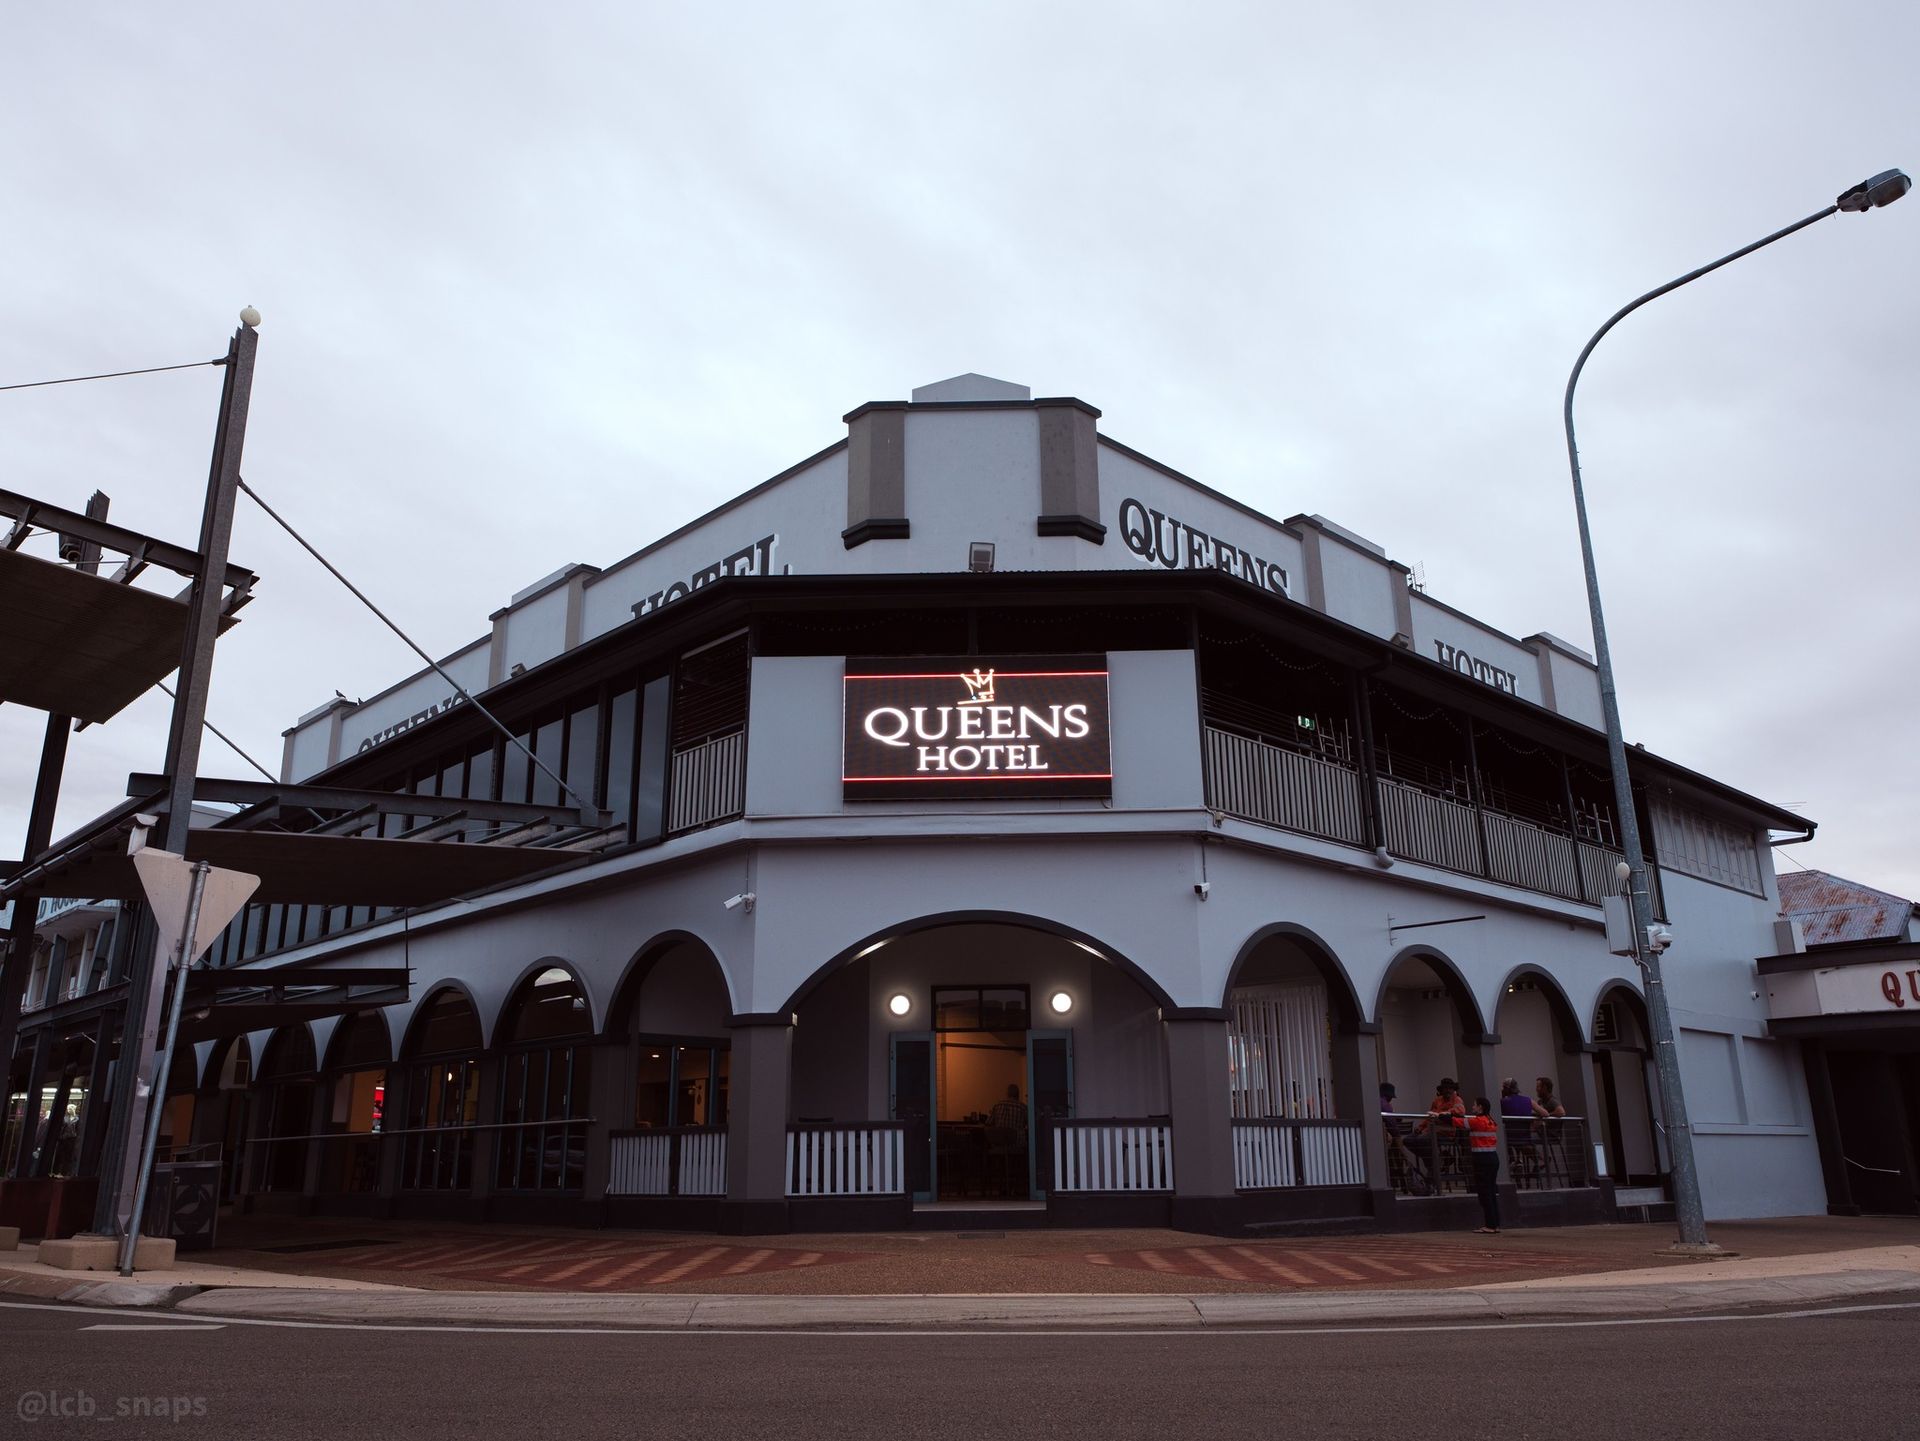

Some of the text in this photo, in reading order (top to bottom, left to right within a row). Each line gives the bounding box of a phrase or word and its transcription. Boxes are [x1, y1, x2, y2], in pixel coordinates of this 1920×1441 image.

[1119, 498, 1288, 599] QUEENS
[864, 704, 1090, 747] QUEENS
[916, 745, 1049, 771] HOTEL
